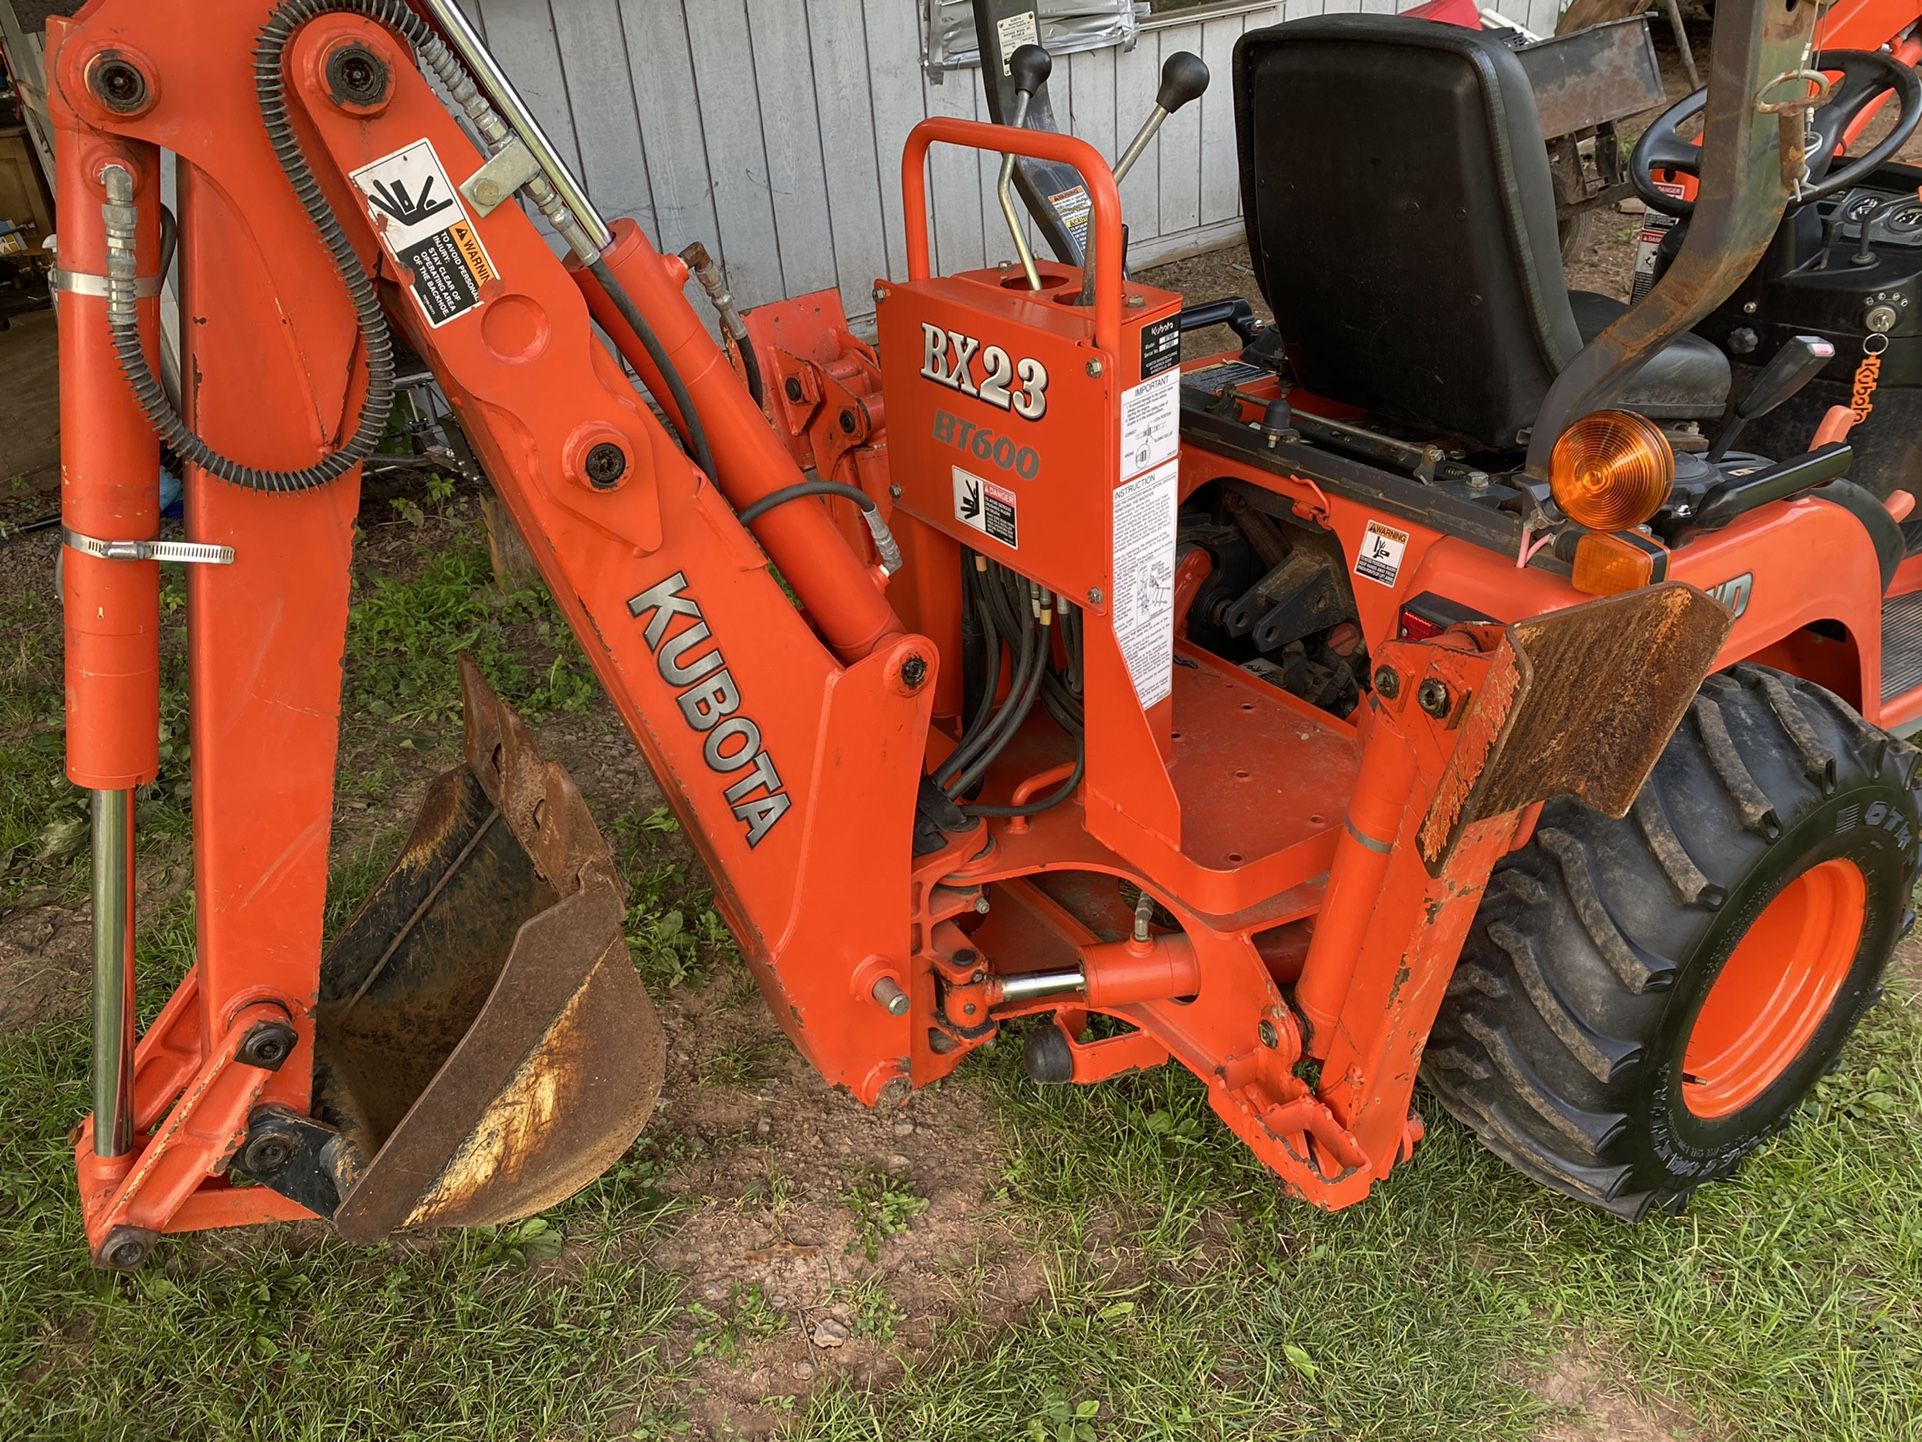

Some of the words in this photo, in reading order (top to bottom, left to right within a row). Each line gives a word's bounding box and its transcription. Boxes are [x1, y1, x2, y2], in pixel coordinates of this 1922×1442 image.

[428, 247, 443, 268] STAY
[438, 266, 455, 292] CLEAR
[451, 290, 461, 301] OF
[432, 235, 451, 264] INJURY:
[440, 231, 450, 242] TO
[446, 243, 462, 266] AVOID
[458, 265, 480, 301] PERSONAL
[463, 240, 490, 283] WARNIN
[413, 255, 423, 266] OF
[419, 266, 432, 281] THE
[426, 280, 450, 317] BACKHOE.
[421, 251, 446, 293] OPERATING
[442, 291, 456, 312] AREA
[1151, 321, 1174, 336] Kubota
[920, 321, 1049, 422] BX23
[1134, 375, 1170, 397] IMPORTANT
[1853, 362, 1878, 423] Kubota
[932, 410, 1040, 480] BT600
[990, 485, 1014, 505] DANGER
[1376, 525, 1407, 543] WARNING
[626, 570, 792, 850] KUBOTA
